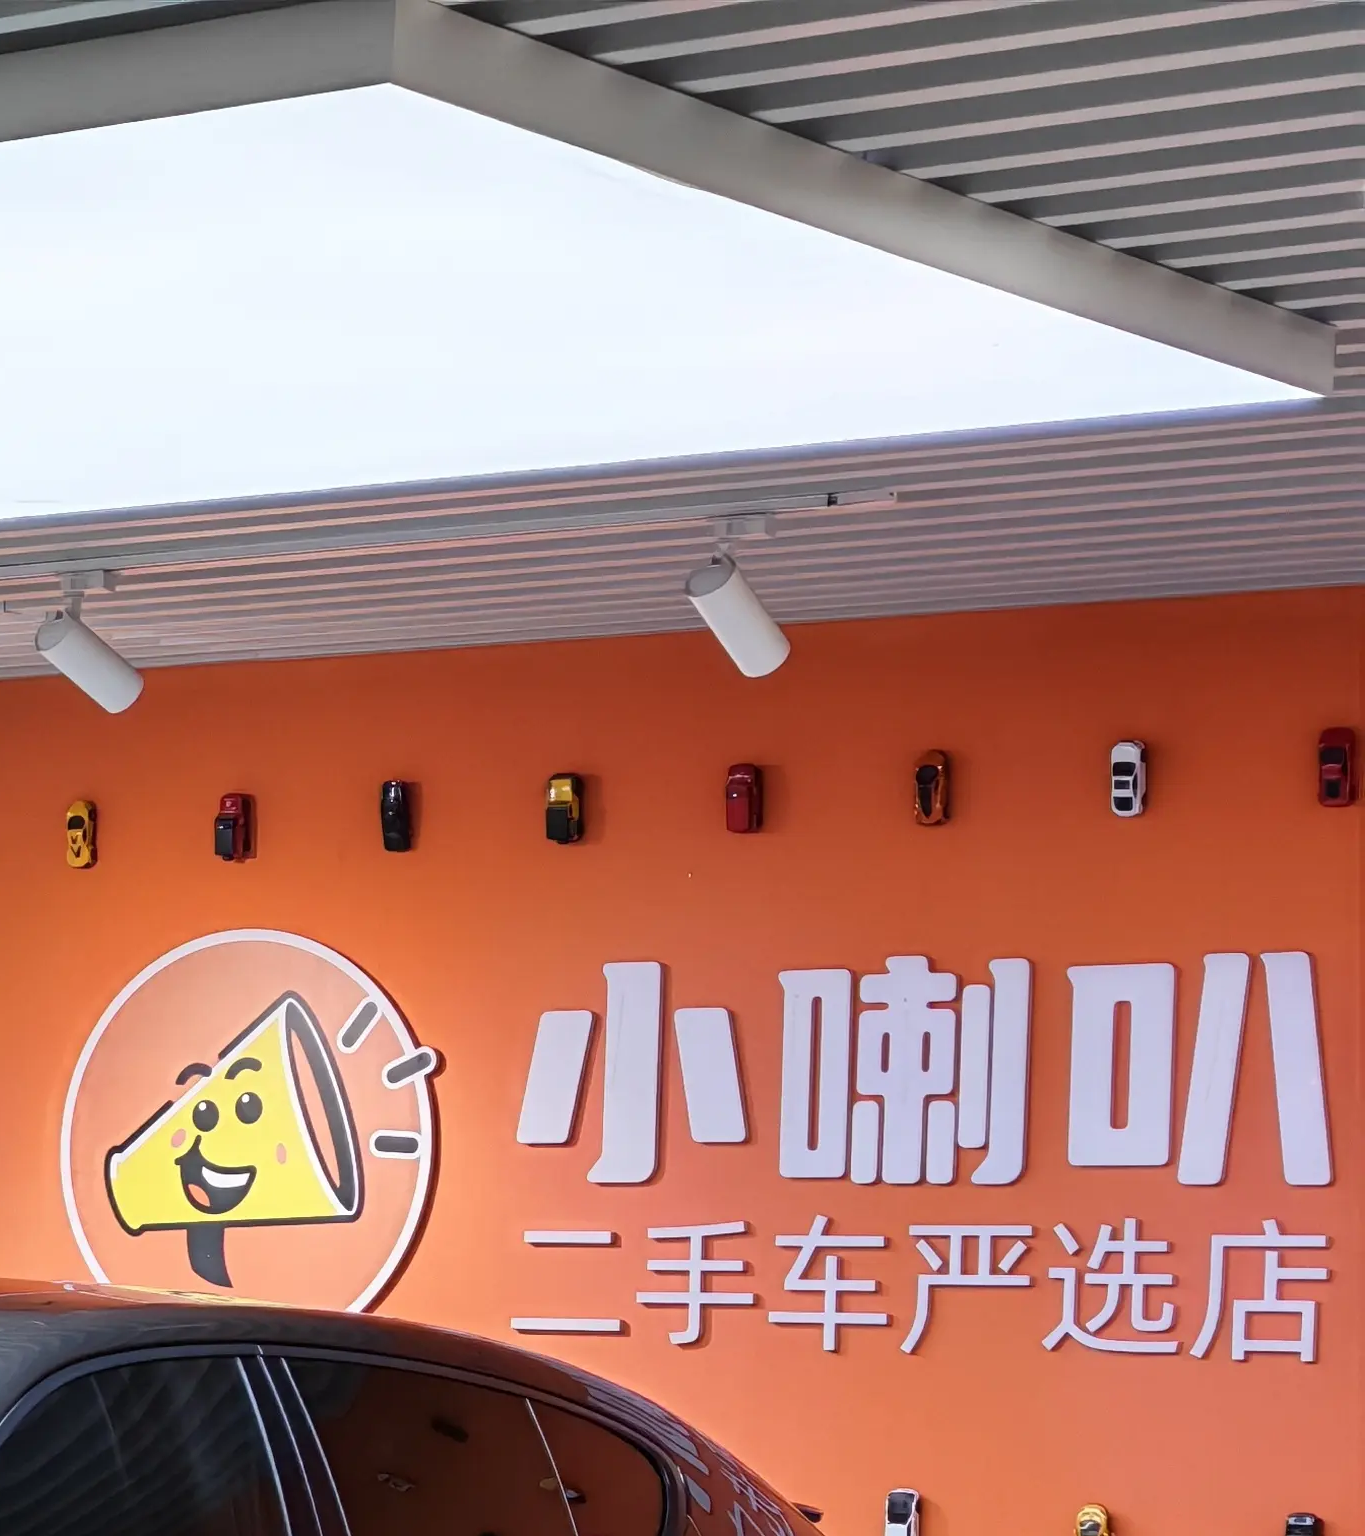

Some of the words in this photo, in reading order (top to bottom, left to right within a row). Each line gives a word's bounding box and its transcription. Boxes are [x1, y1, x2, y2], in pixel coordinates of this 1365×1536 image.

[515, 951, 1331, 1186] 小喇叭
[510, 1214, 1330, 1362] 二手车严选店
